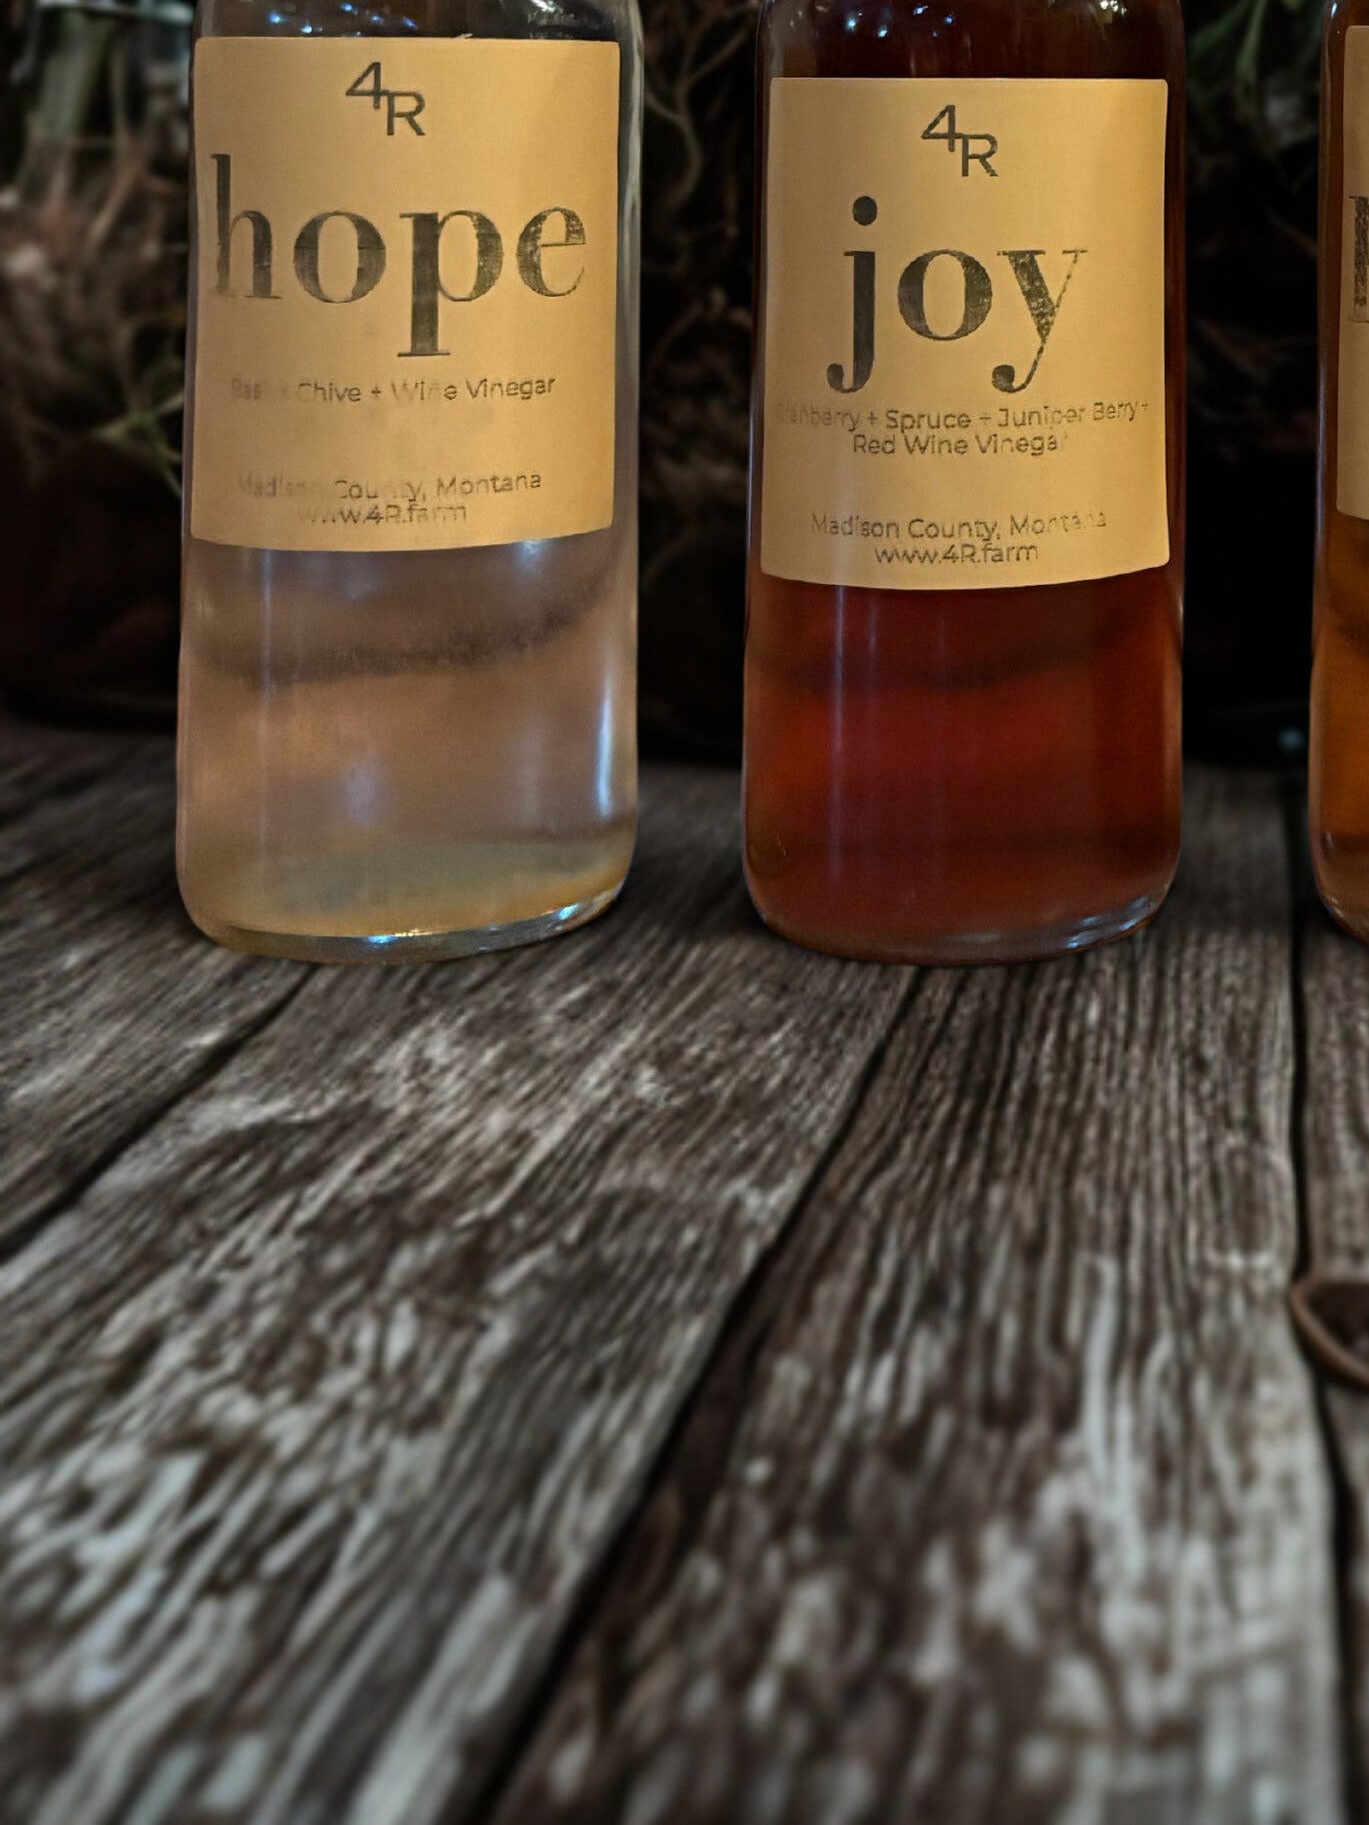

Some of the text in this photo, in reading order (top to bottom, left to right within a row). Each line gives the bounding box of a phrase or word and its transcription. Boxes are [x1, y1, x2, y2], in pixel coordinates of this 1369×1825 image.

[345, 62, 425, 136] 4R
[922, 104, 998, 177] 4R
[210, 153, 586, 357] hope
[826, 195, 1089, 393] joy
[232, 377, 268, 400] Bas
[299, 379, 362, 402] Chive
[391, 378, 457, 401] Wine
[466, 377, 555, 401] Vinegar
[776, 402, 860, 431] ranberry
[866, 412, 877, 425] +
[885, 410, 971, 434] Spruce
[998, 404, 1084, 430] Juniper
[1093, 401, 1138, 421] Berry
[853, 434, 896, 455] Red
[904, 434, 968, 455] Wine
[238, 472, 541, 503] Madis Couy, Montana
[302, 504, 467, 526] w.4R.farm
[812, 512, 900, 539] Madison
[908, 517, 1001, 543] County,
[876, 543, 1038, 565] www.4R.farm
